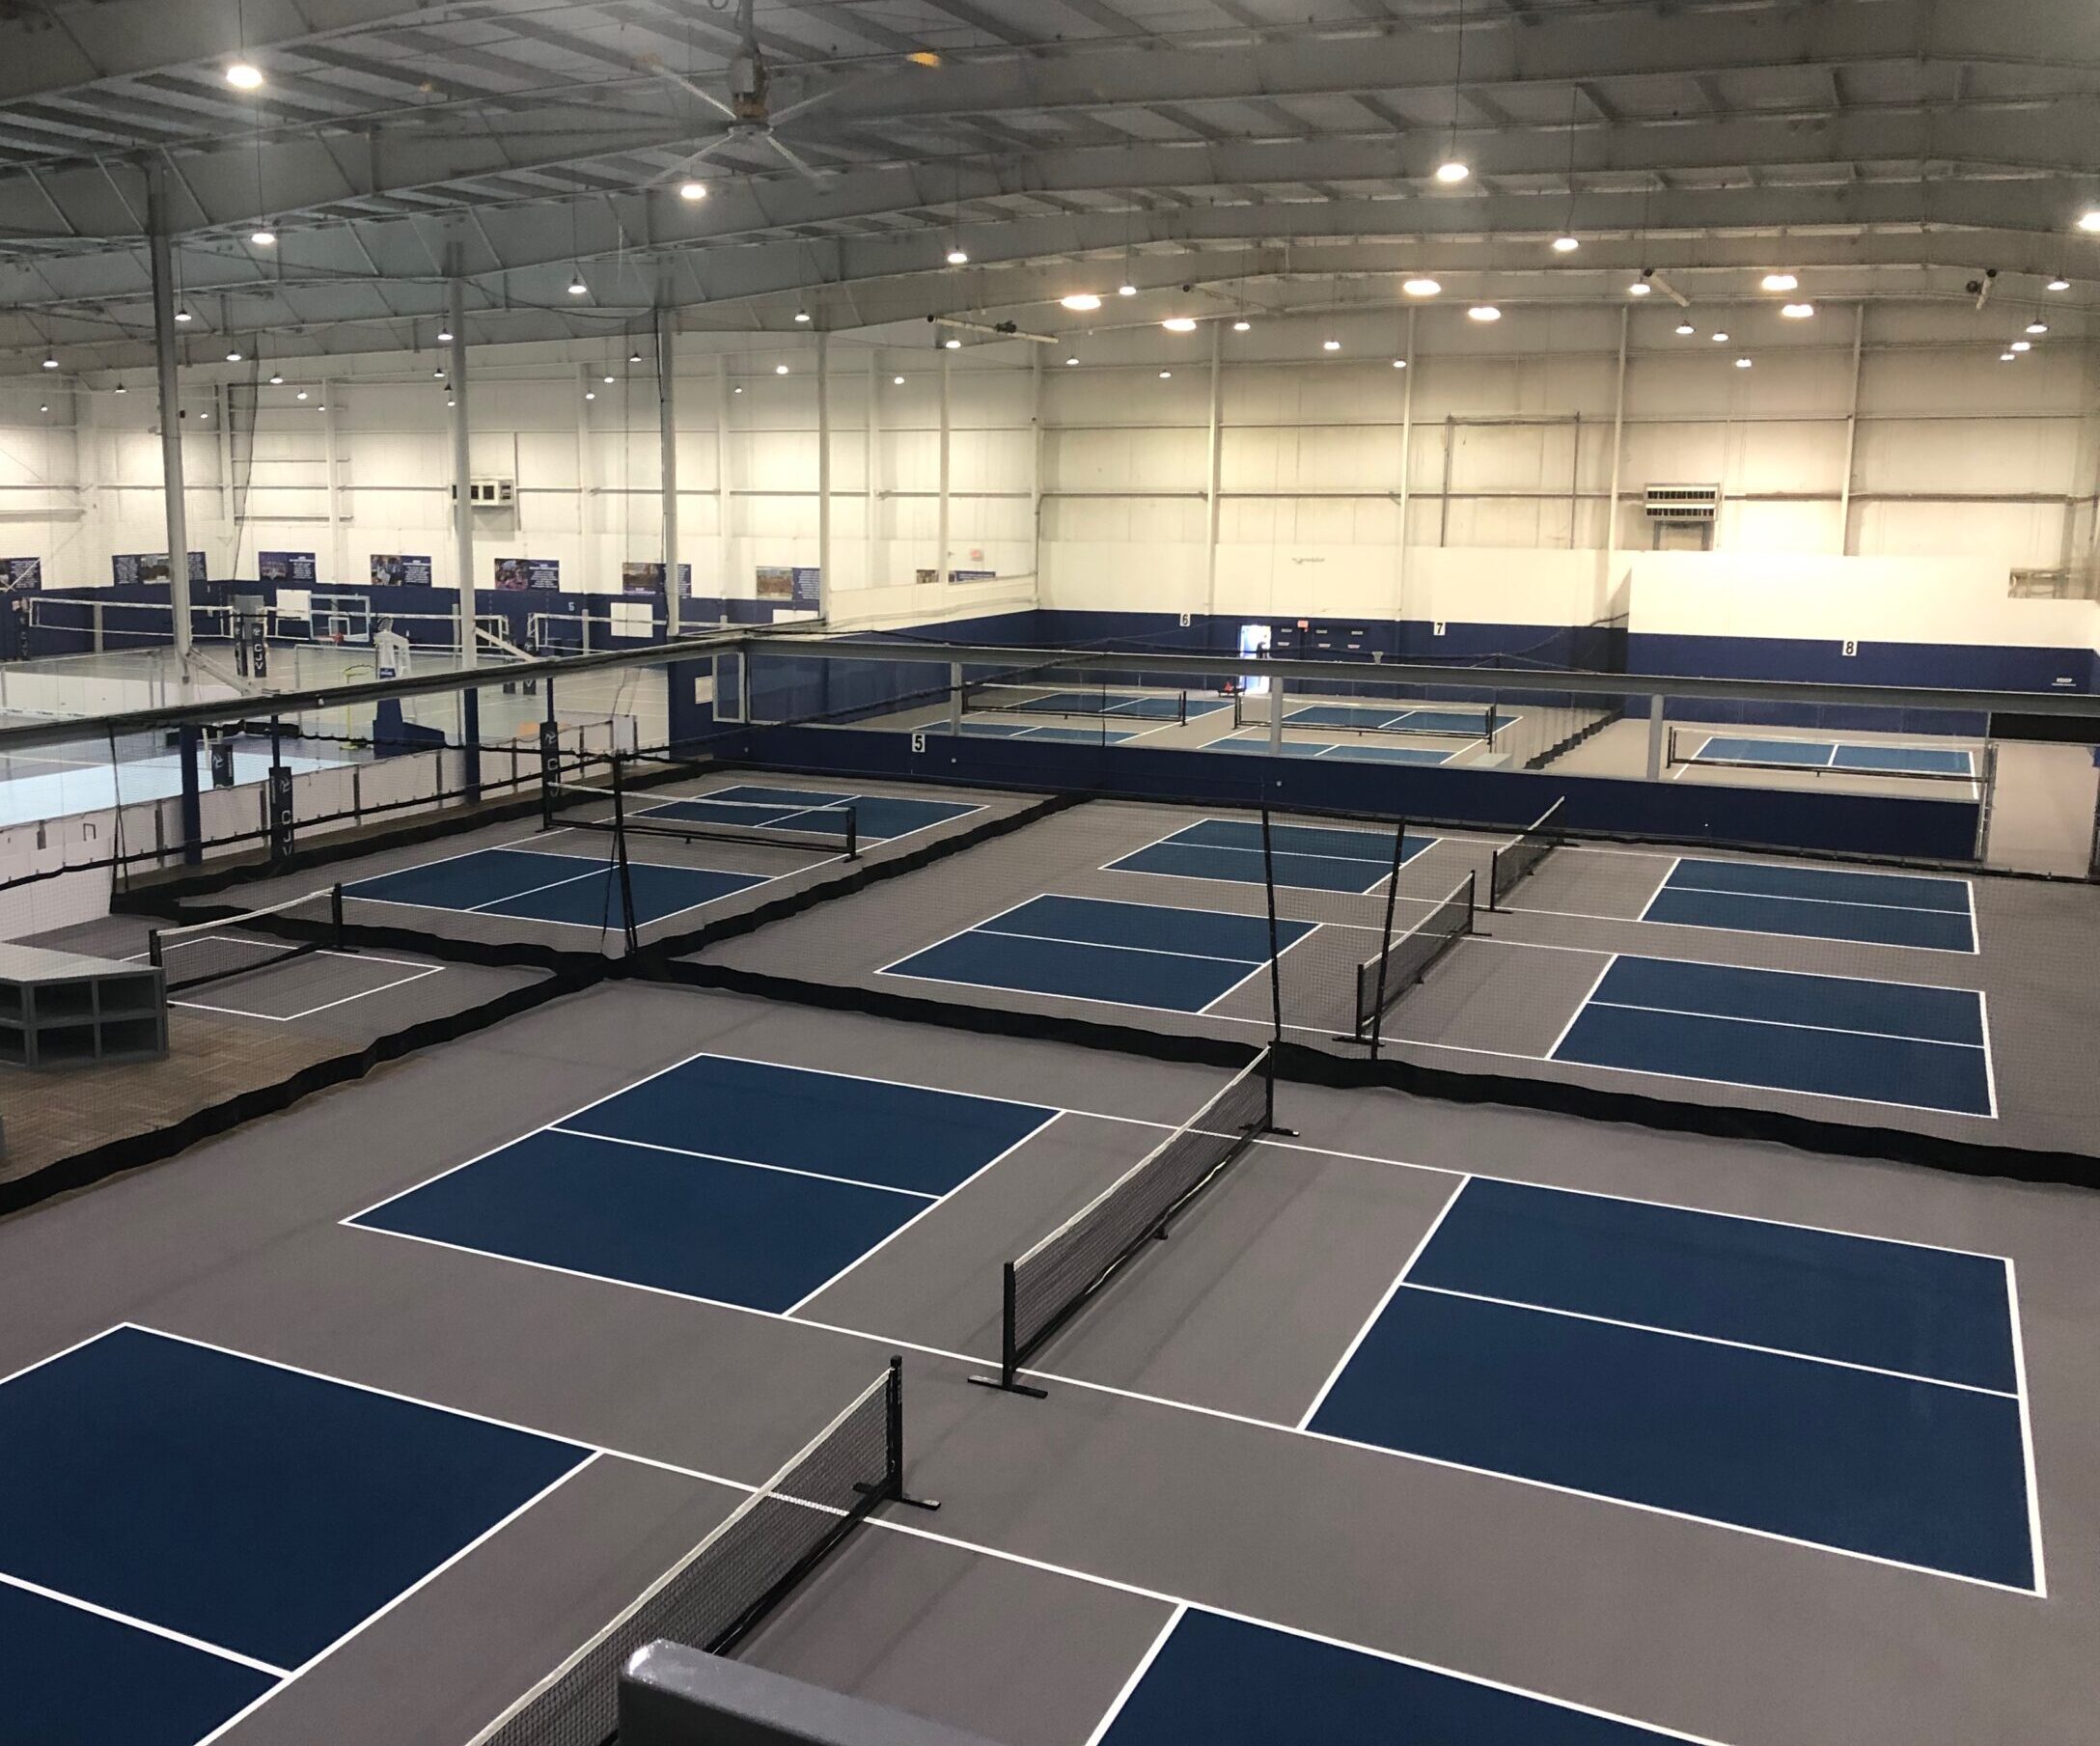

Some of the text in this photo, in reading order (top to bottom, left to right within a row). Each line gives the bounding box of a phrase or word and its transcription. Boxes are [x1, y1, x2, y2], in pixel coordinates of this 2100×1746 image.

[1182, 614, 1188, 625] 6
[1436, 623, 1443, 634] 7
[1845, 641, 1854, 654] 8
[254, 643, 263, 670] CJV
[914, 734, 923, 751] 5
